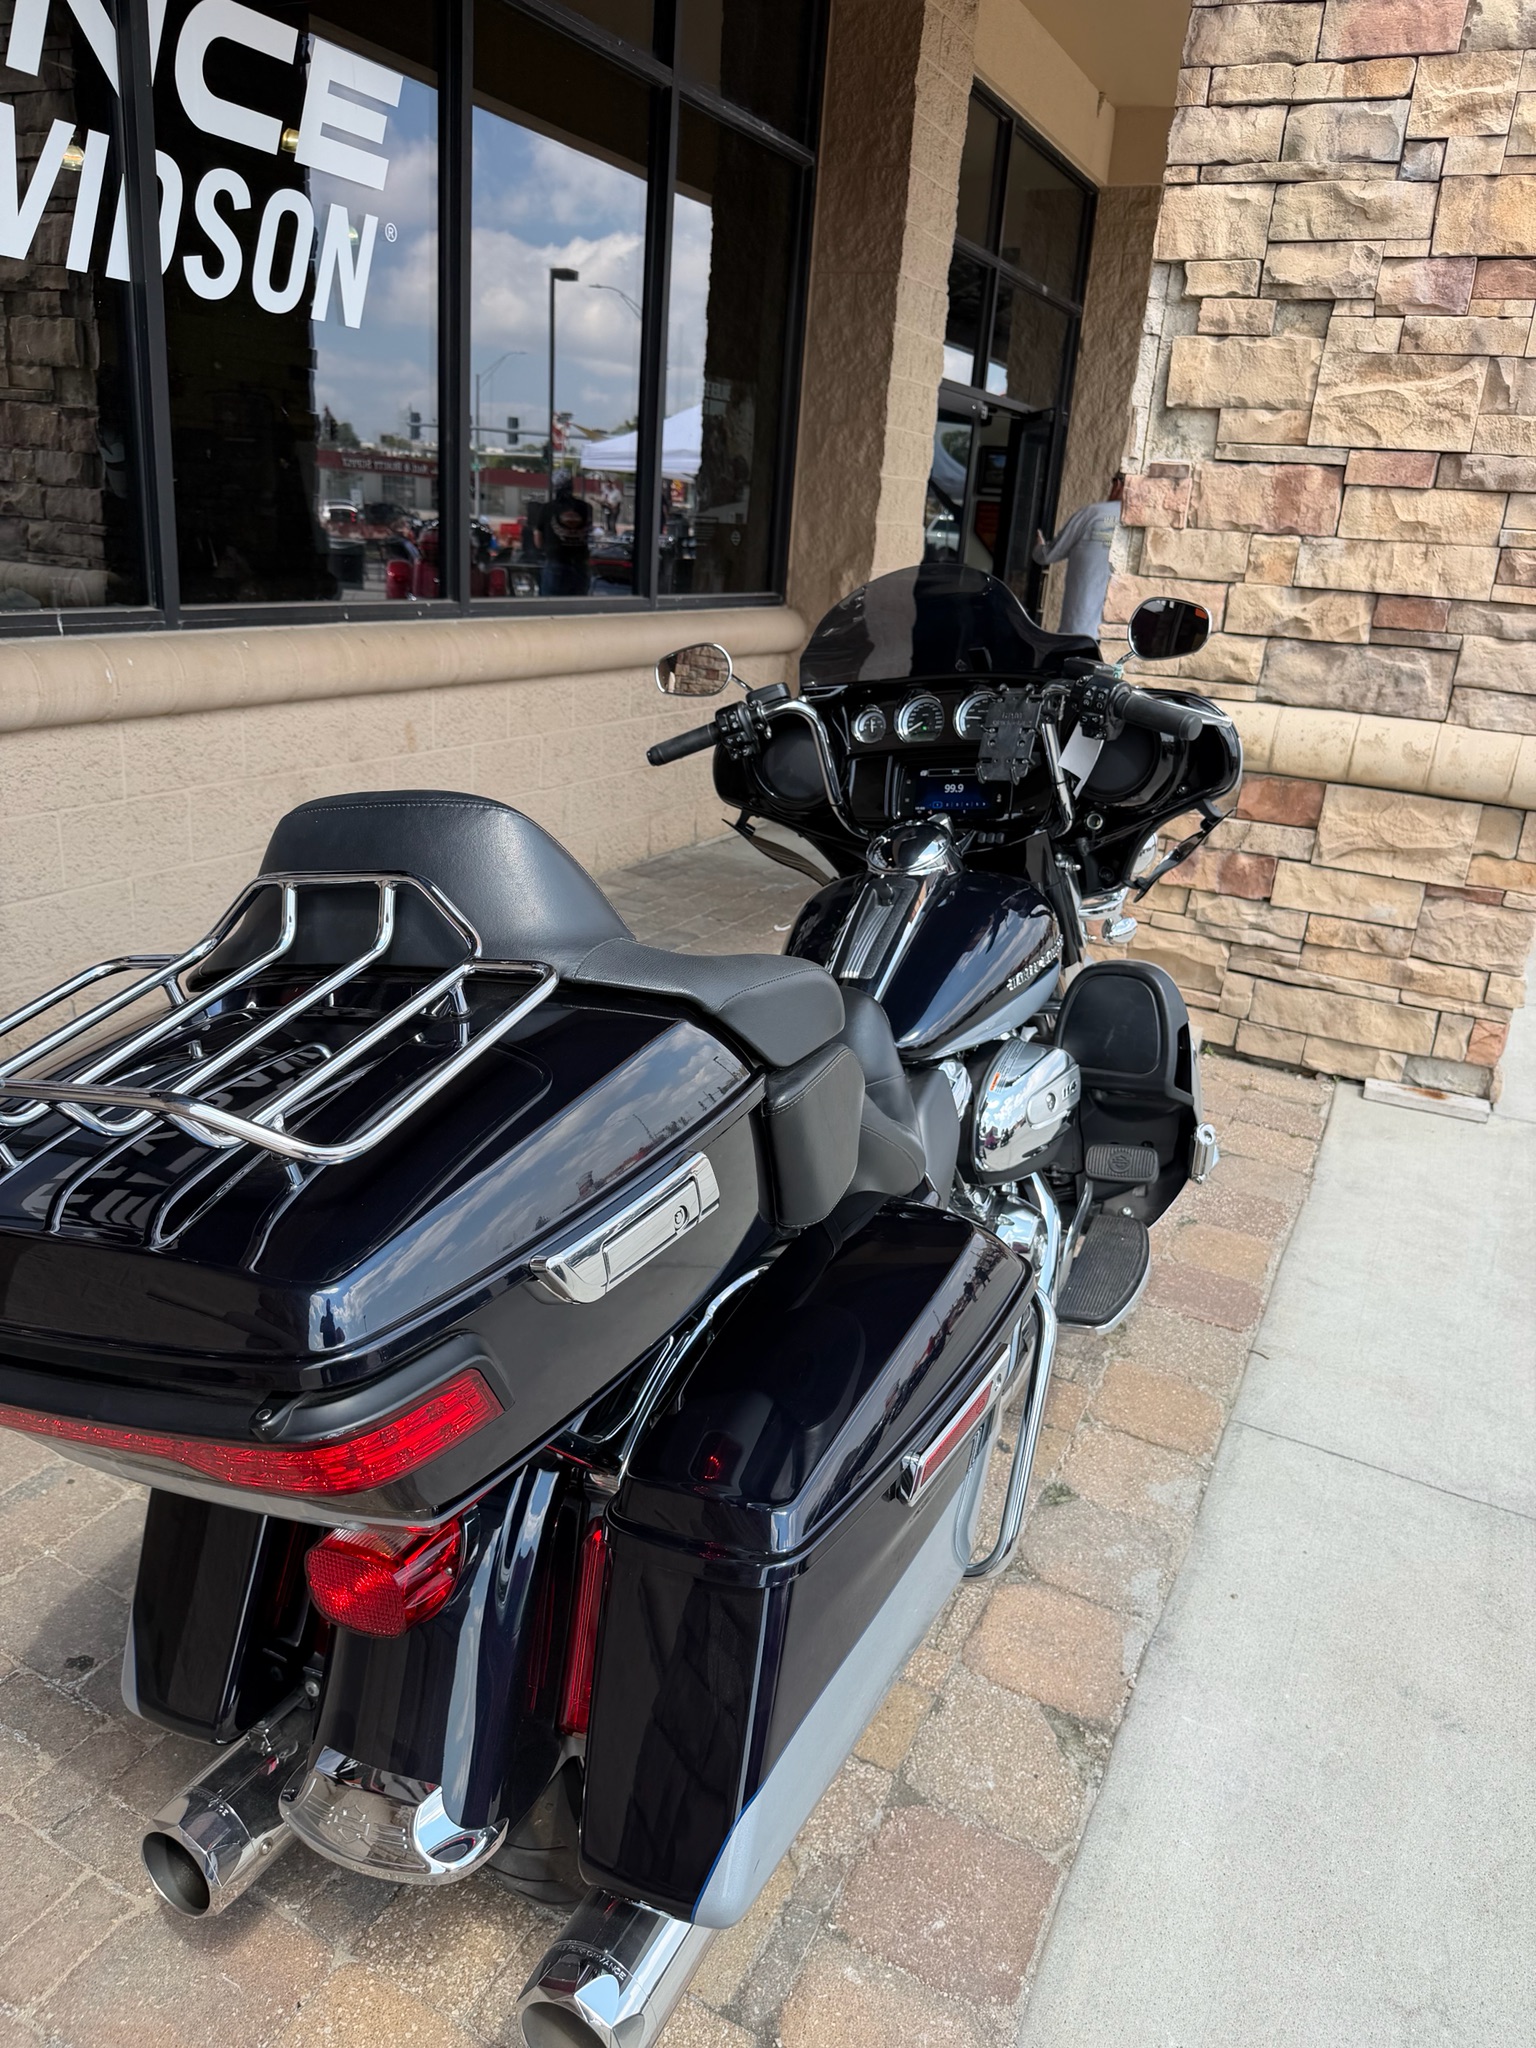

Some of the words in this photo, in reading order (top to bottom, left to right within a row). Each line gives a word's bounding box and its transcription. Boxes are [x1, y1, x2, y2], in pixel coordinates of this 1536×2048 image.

[944, 783, 964, 793] 99.9
[1061, 1078, 1078, 1100] 114
[566, 1944, 628, 1982] PERFORMANCE
